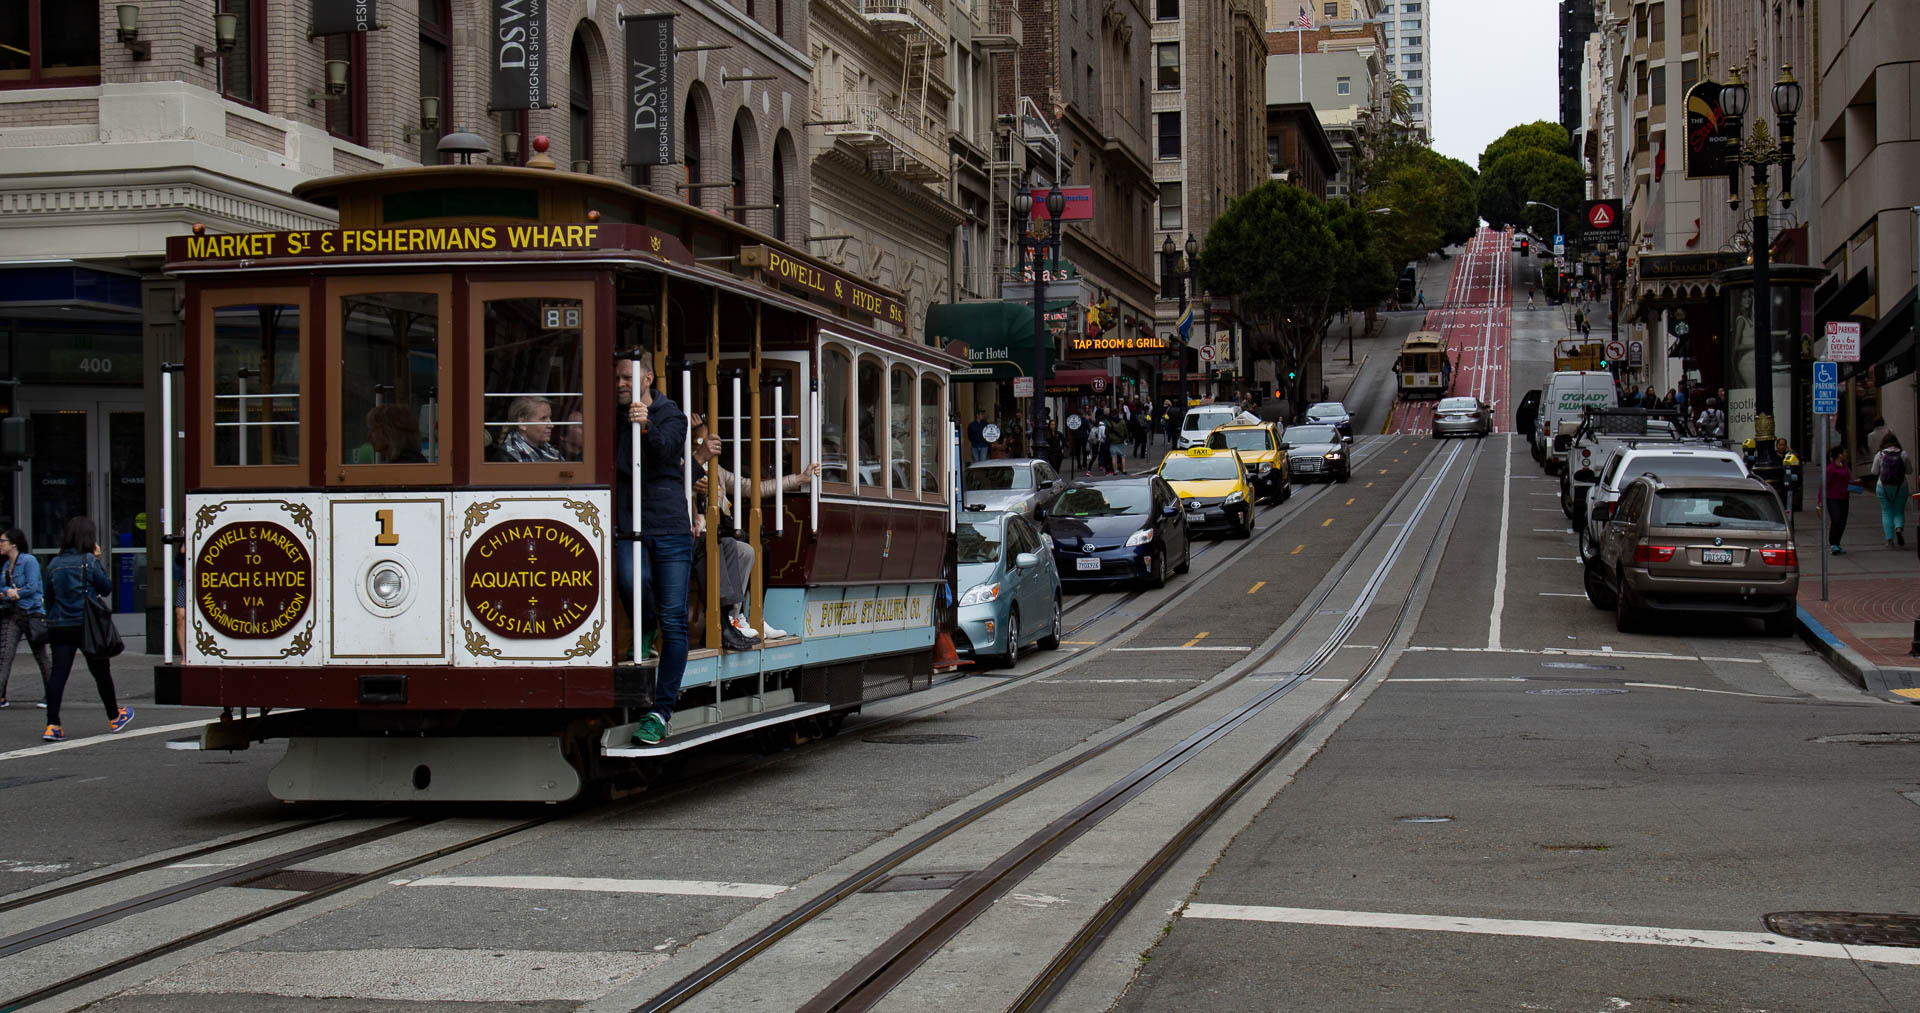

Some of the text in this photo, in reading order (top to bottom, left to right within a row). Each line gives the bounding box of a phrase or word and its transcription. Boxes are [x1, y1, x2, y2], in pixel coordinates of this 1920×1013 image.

[499, 0, 526, 71] DSW
[530, 18, 540, 53] SHOE
[529, 54, 540, 110] DESIGNER
[634, 60, 657, 132] DSW
[659, 21, 669, 165] DESIGNER SHOE WAREHOUSE
[186, 233, 277, 260] MARKET
[320, 231, 335, 252] &
[342, 226, 497, 252] FISHERMANS
[507, 224, 600, 249] WHARF
[769, 252, 825, 292] POWELL
[834, 279, 843, 299] &
[852, 288, 882, 315] HYDE
[1827, 323, 1858, 334] NO PARKING
[1073, 337, 1165, 350] TAP ROOM & GRILL
[1463, 344, 1504, 352] ONLY
[1830, 343, 1855, 351] EVERYDAY
[985, 346, 1009, 360] Hotel
[79, 358, 112, 373] 400
[1093, 378, 1105, 389] 78
[1815, 382, 1836, 390] PARKING
[1561, 393, 1608, 401] O'GRADY
[42, 478, 67, 486] CHASE
[375, 509, 399, 546] 1
[203, 526, 304, 566] POWELL & MARKET
[479, 525, 585, 558] CHINATOWN
[244, 554, 262, 565] TO
[201, 570, 305, 588] BEACH & HYDE
[470, 570, 593, 588] AQUATIC PARK
[243, 596, 264, 607] VIA
[202, 592, 305, 634] WASHINGTON & JACKSON
[476, 600, 588, 634] RUSSIAN HILL
[820, 600, 858, 628] POWELL
[875, 598, 908, 623] RAILWAY
